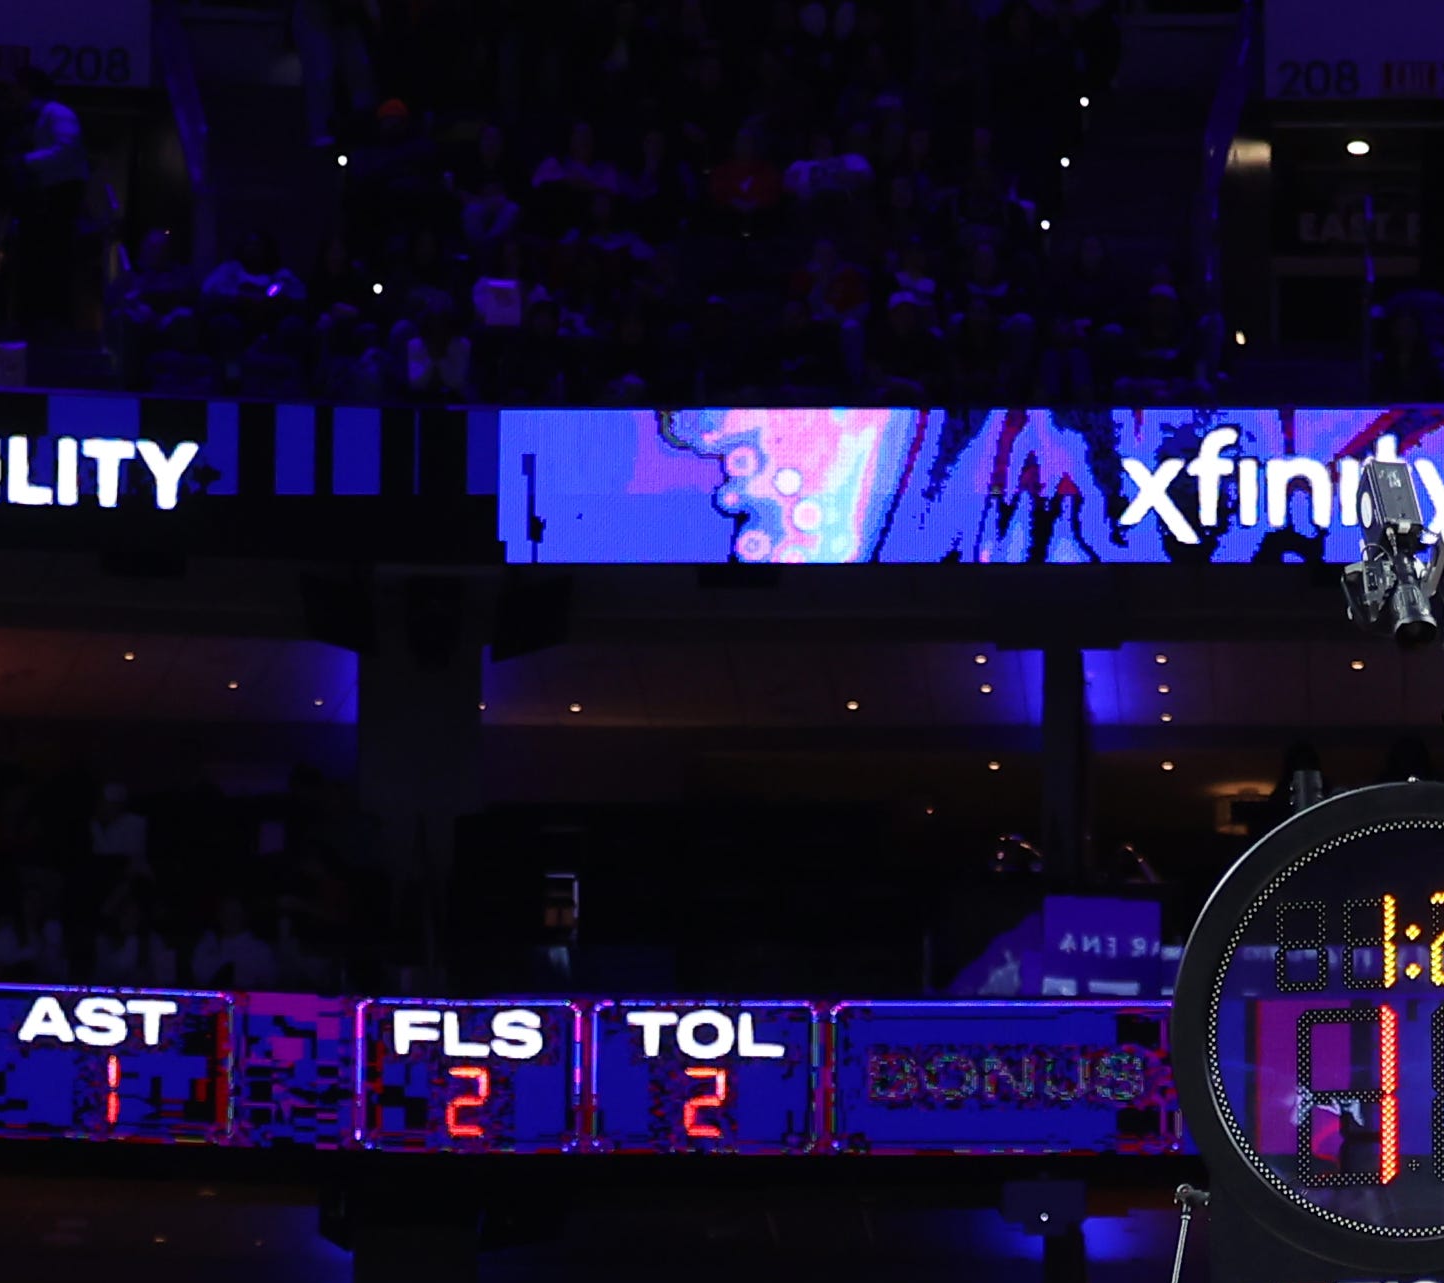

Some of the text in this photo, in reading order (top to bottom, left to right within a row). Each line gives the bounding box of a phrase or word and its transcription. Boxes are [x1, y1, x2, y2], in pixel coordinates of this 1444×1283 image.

[1278, 60, 1359, 97] 208
[17, 996, 178, 1047] AST
[392, 1008, 544, 1060] FLS
[626, 1009, 786, 1060] TOL
[105, 1056, 120, 1124] 1
[445, 1065, 491, 1137] 2
[682, 1066, 727, 1138] 2
[865, 1048, 1144, 1103] BONUS
